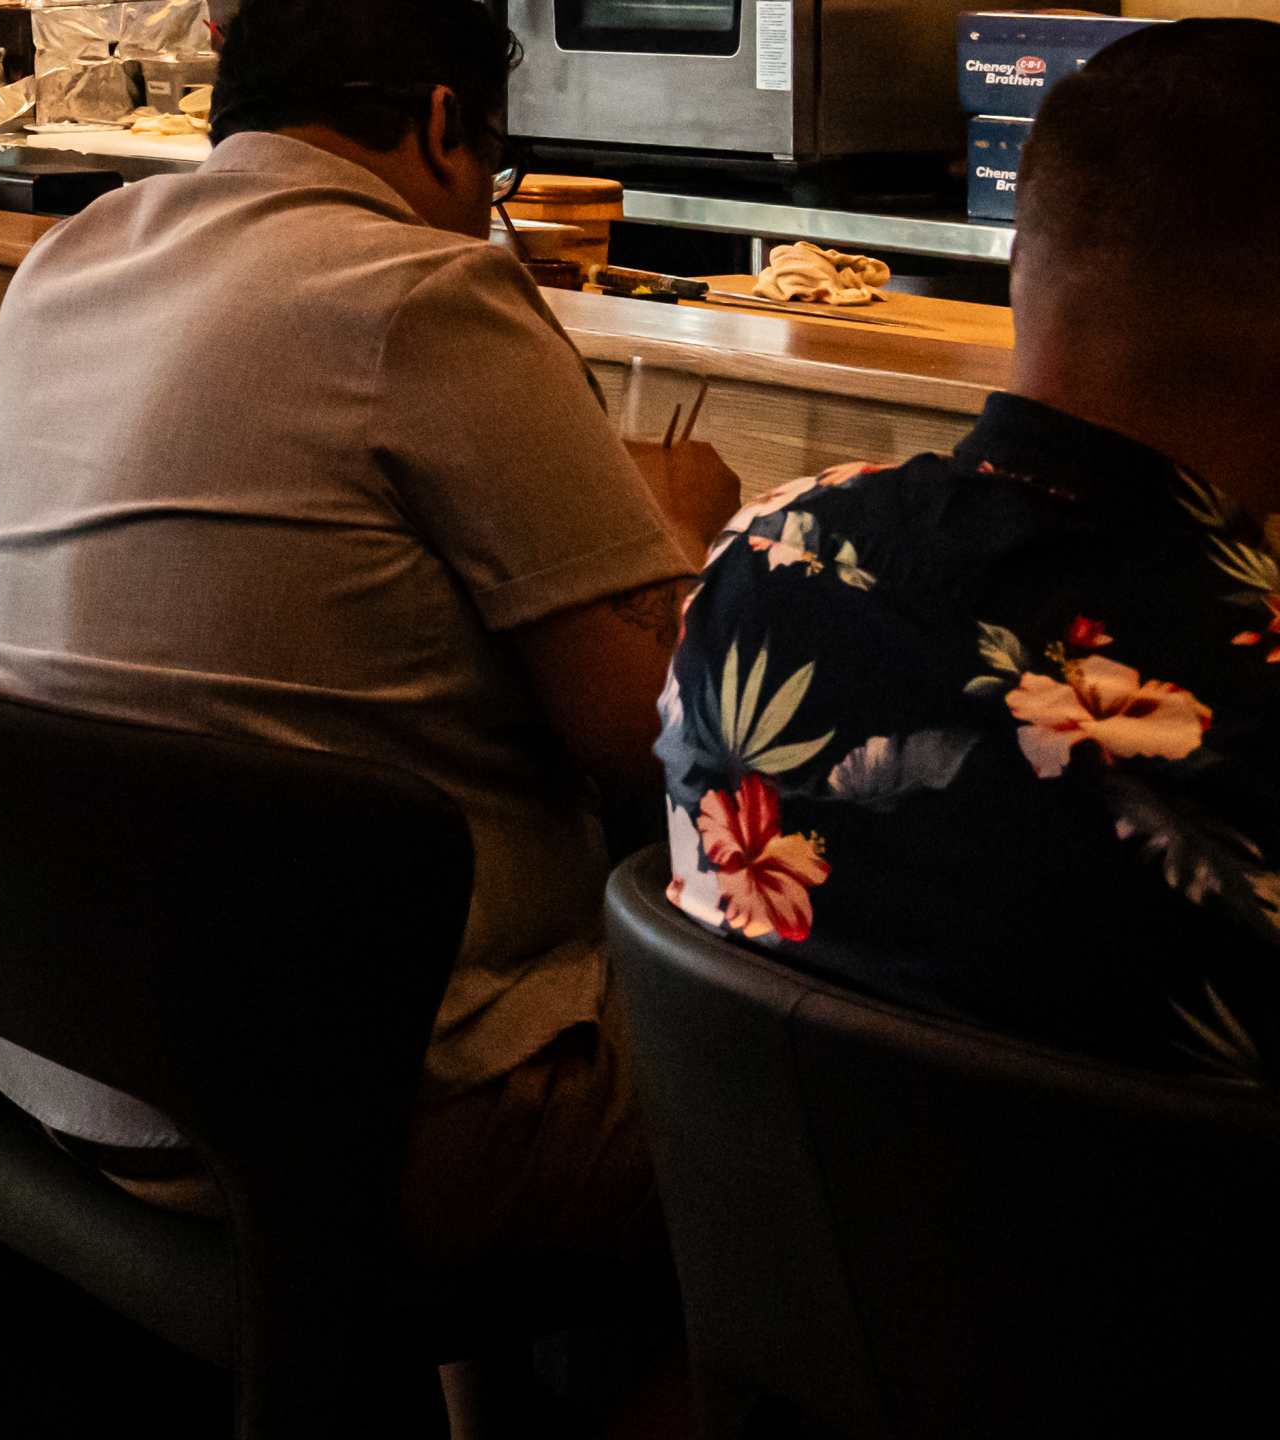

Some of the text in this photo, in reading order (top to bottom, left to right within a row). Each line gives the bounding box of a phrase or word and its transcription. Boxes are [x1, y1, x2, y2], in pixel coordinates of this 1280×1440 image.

[965, 59, 1015, 75] Cheney
[985, 73, 1045, 87] Brothers
[975, 166, 1017, 180] Chene
